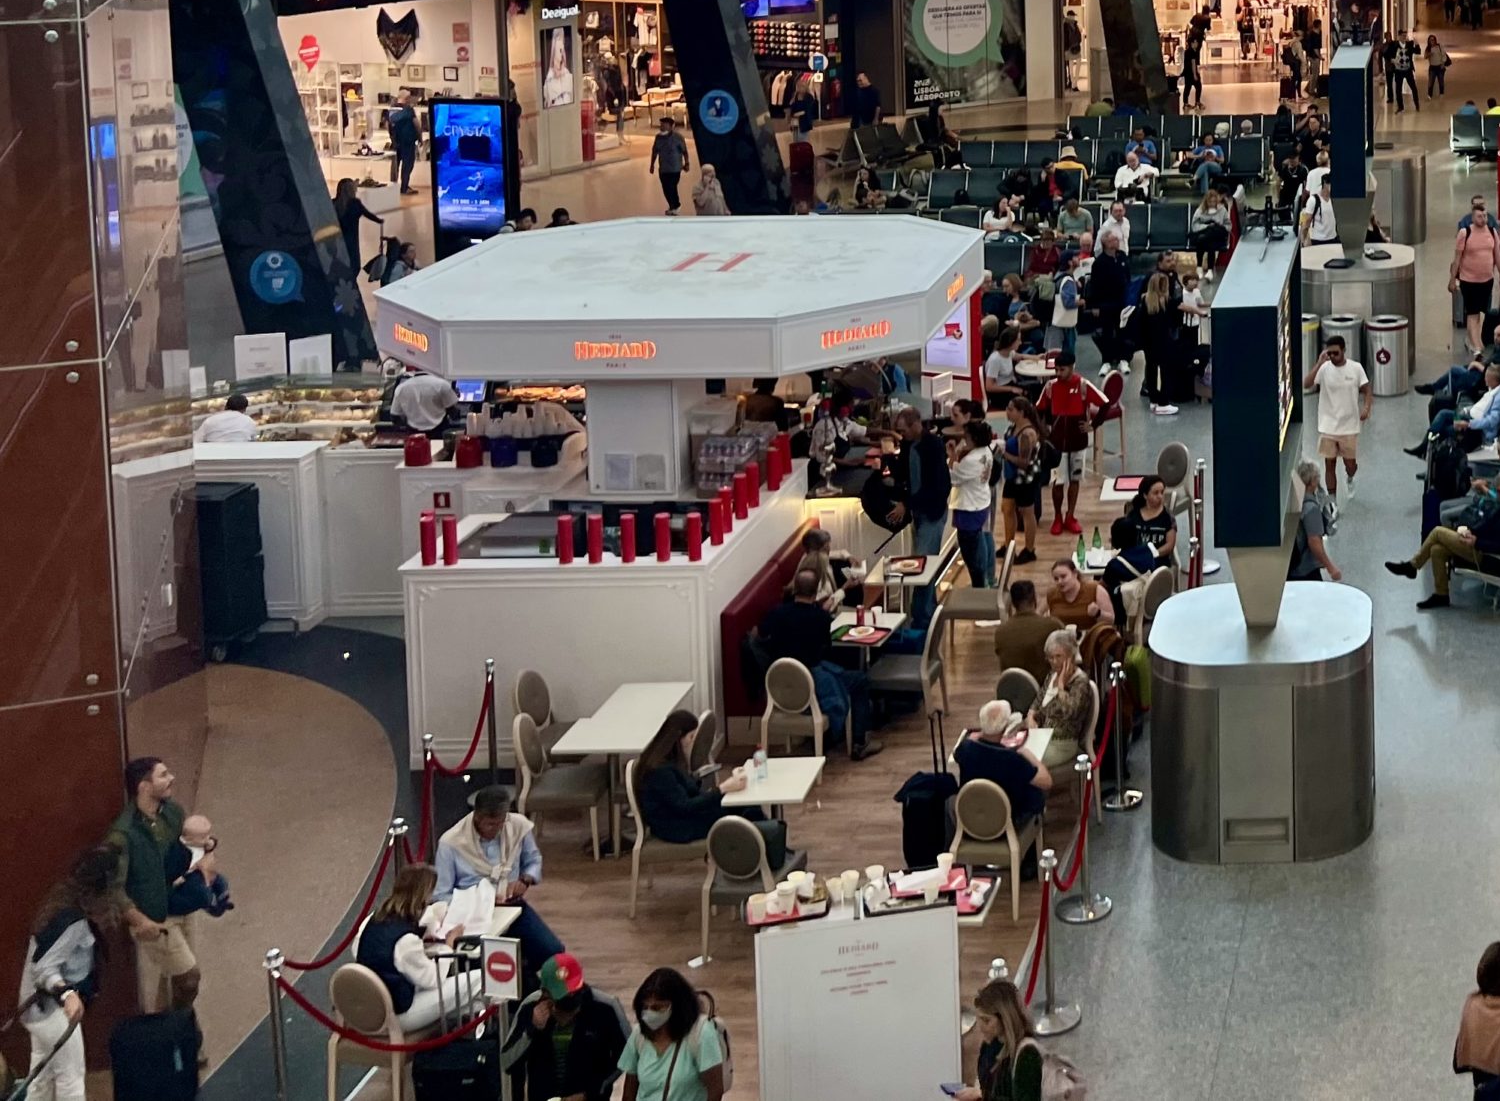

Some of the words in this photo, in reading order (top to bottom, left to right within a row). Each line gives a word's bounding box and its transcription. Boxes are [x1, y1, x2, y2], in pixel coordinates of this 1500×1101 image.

[913, 85, 940, 95] LISBOA
[914, 90, 961, 102] AEROPORTO
[574, 340, 657, 360] HEDIARD
